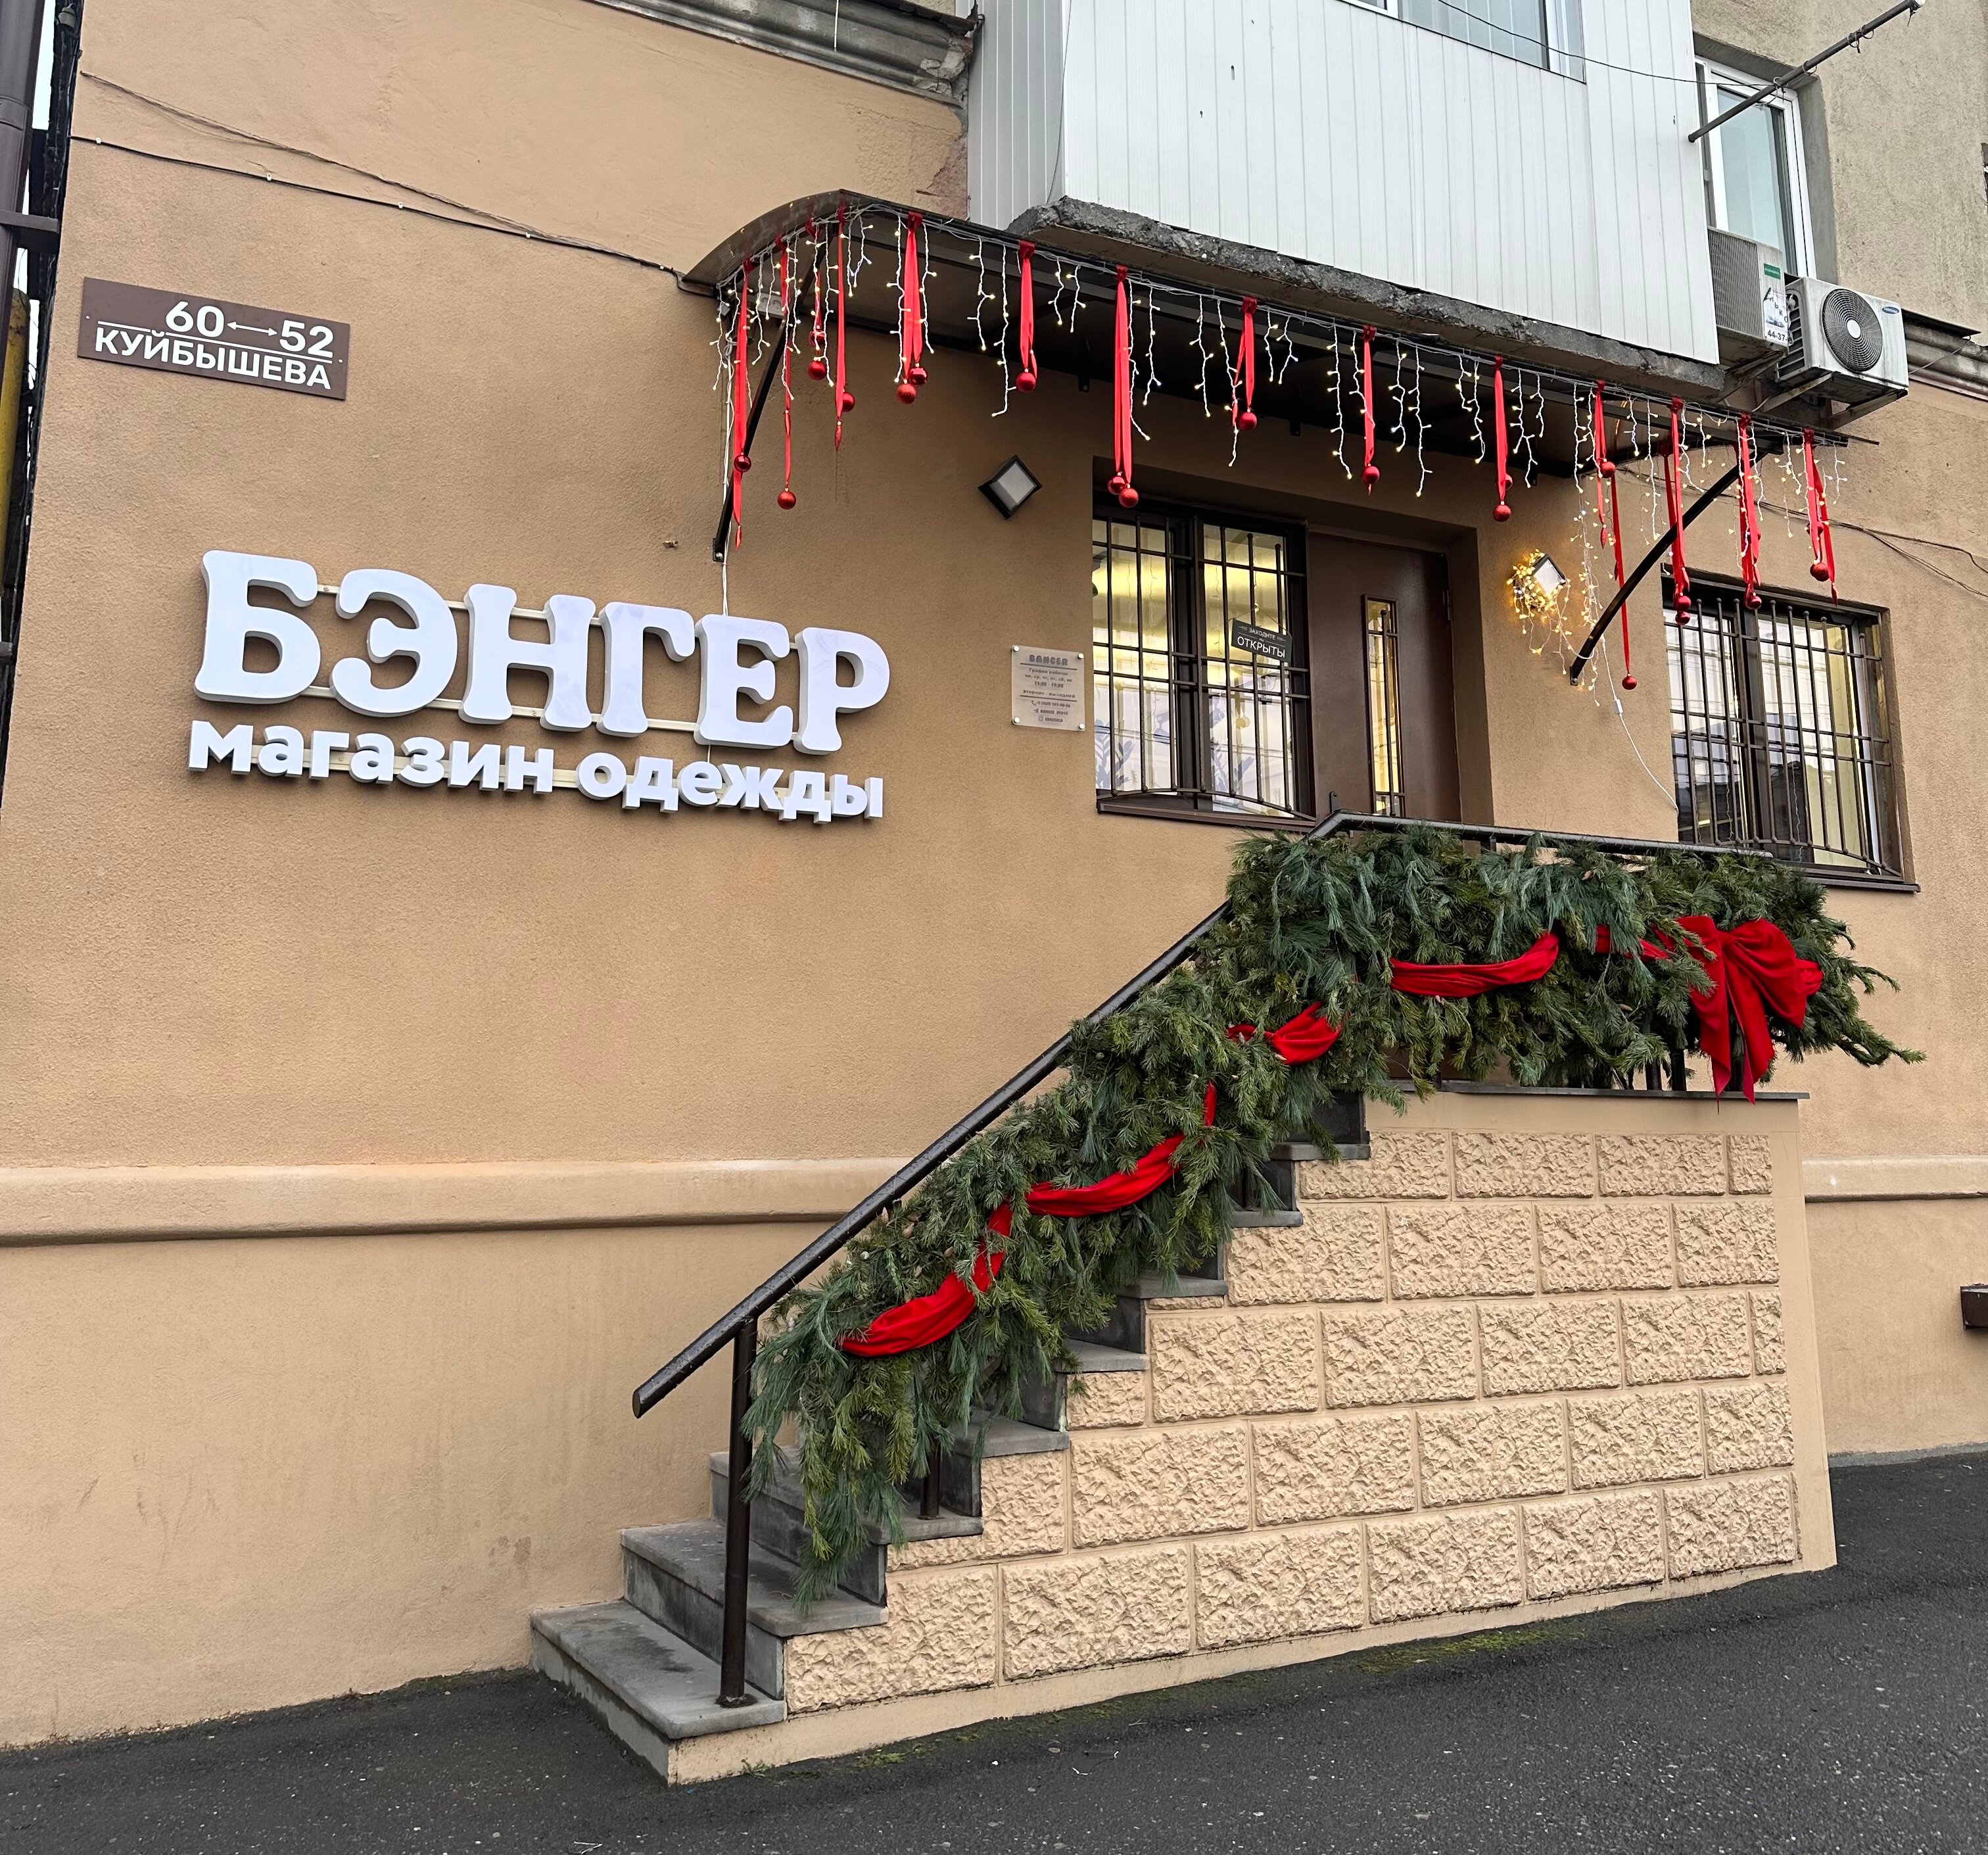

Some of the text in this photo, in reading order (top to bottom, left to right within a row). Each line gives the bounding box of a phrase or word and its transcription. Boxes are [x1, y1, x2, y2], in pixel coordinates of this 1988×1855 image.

[165, 301, 334, 358] 60 52
[95, 327, 331, 390] КУЙБЫШЕВА
[194, 550, 890, 755] БЭНГЕР
[1030, 655, 1068, 665] BANGER
[1237, 636, 1285, 658] ОТКРЫТЫ
[1248, 627, 1276, 640] ЗАХОДИТЕ
[188, 720, 884, 825] магазин одежды
